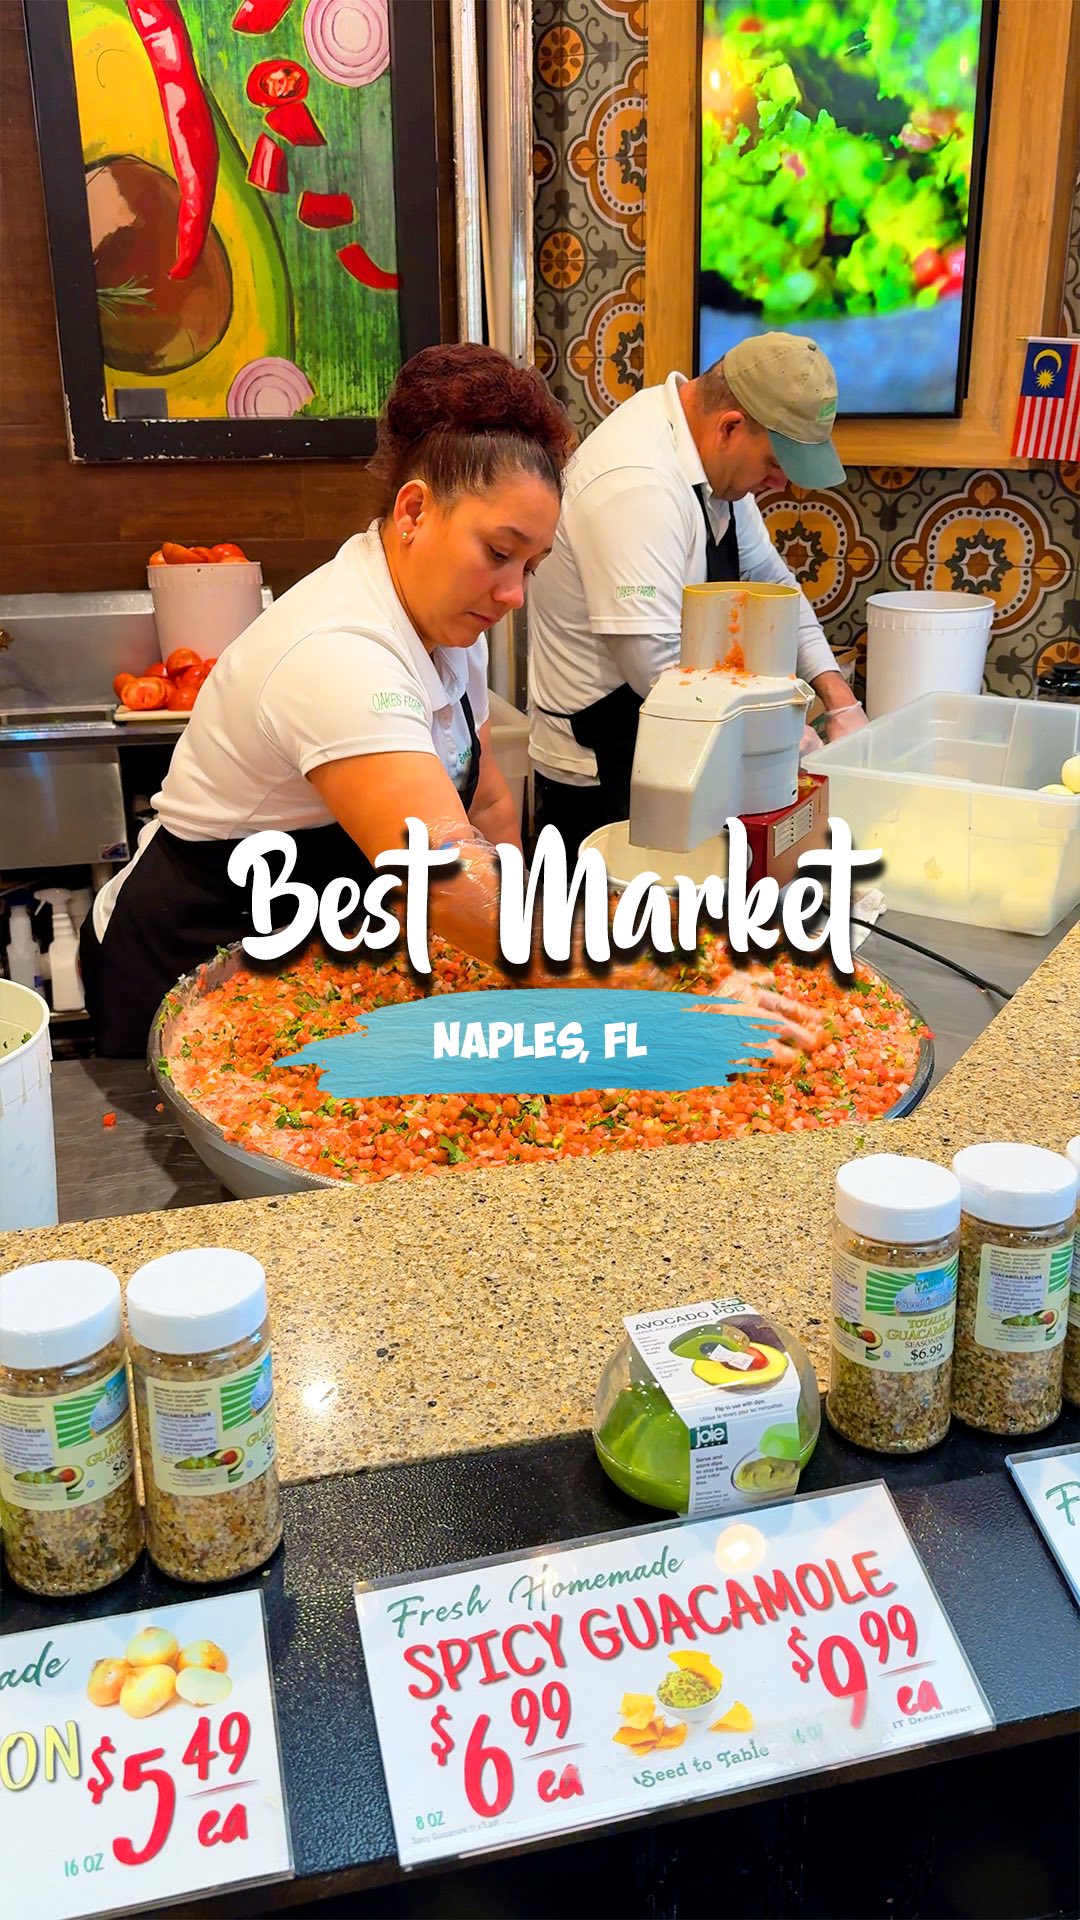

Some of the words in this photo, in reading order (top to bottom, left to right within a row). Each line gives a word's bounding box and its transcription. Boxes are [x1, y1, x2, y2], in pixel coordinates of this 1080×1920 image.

[372, 692, 402, 711] OAKES
[635, 1311, 709, 1331] AVOCADO
[712, 1304, 746, 1316] POD
[910, 1342, 943, 1361] $6.99
[695, 1424, 726, 1449] joie
[387, 1584, 493, 1638] Fresh
[508, 1545, 685, 1612] Homemade
[404, 1614, 566, 1699] SPICY
[580, 1550, 897, 1661] GUACAMOLE
[896, 1680, 943, 1716] ea
[892, 1719, 904, 1729] IT
[633, 1762, 688, 1788] Seed
[692, 1757, 712, 1773] to
[716, 1738, 770, 1768] Table
[537, 1763, 585, 1803] ea
[198, 1803, 249, 1848] ea
[415, 1815, 425, 1830] 8
[427, 1811, 446, 1828] OZ
[64, 1859, 79, 1877] 16
[84, 1853, 105, 1872] OZ
